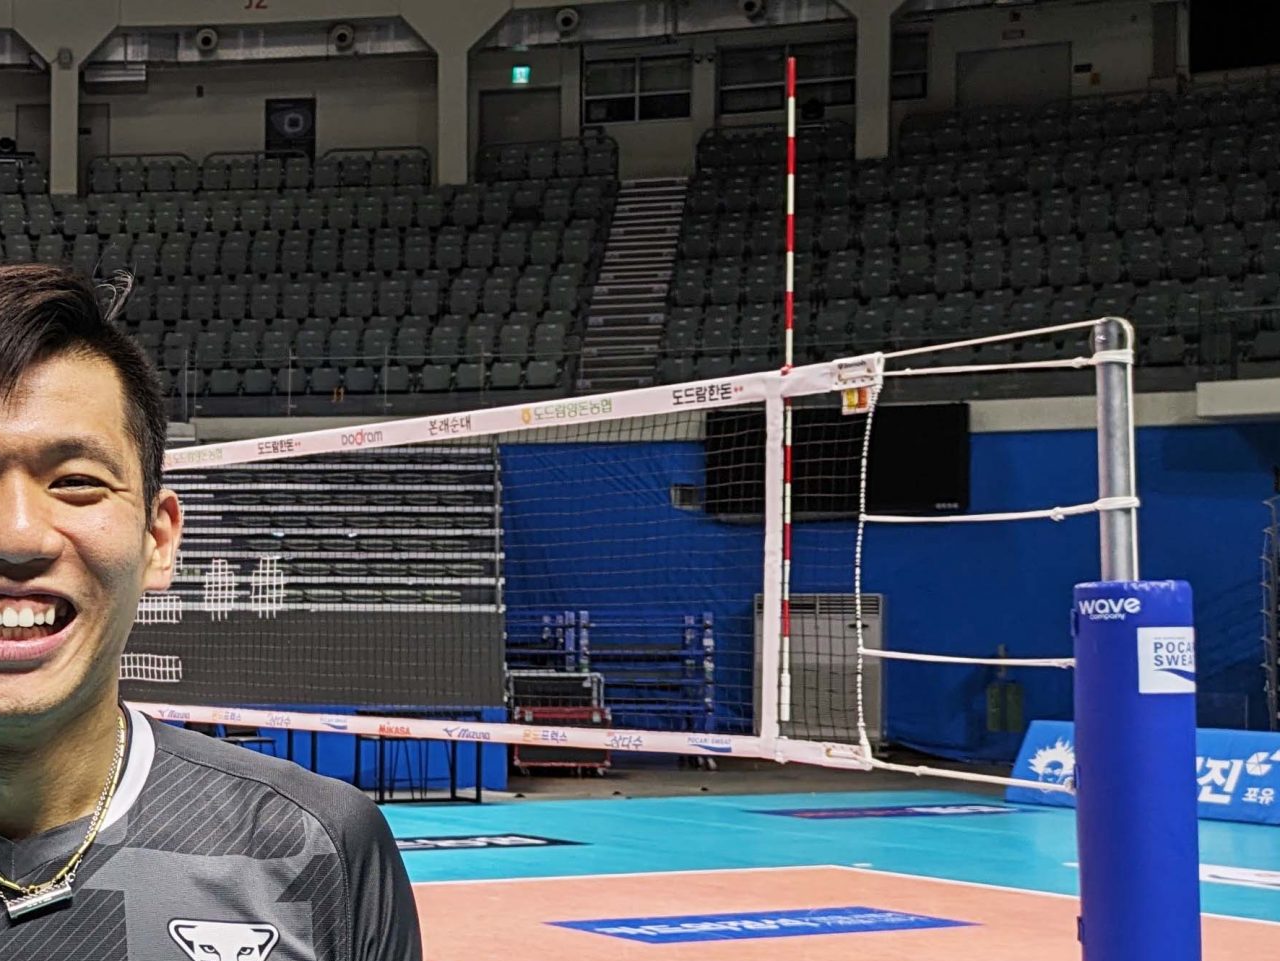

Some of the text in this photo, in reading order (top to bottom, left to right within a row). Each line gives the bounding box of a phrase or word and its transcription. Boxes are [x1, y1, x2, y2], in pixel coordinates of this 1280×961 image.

[672, 382, 732, 406] 도드람한돈
[257, 438, 295, 455] 도드람한돈
[1079, 597, 1141, 615] wave
[1089, 612, 1126, 620] company
[1196, 756, 1243, 805] 진
